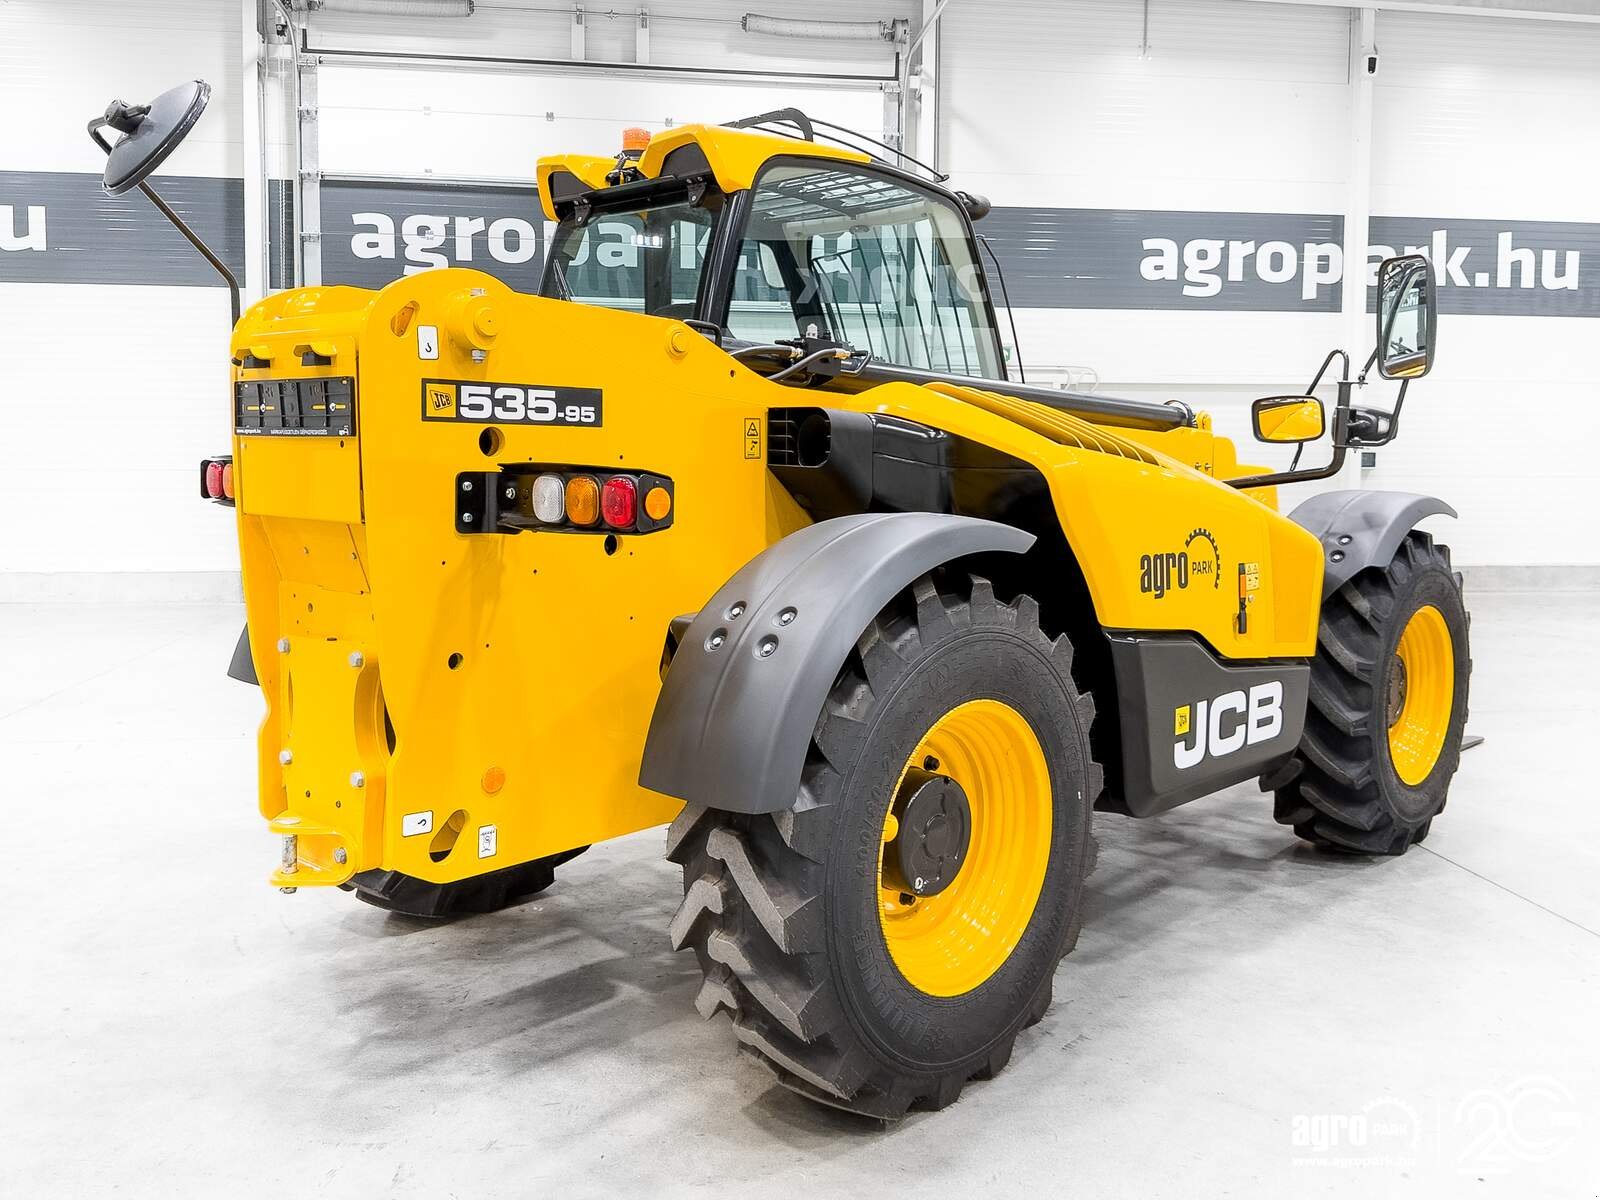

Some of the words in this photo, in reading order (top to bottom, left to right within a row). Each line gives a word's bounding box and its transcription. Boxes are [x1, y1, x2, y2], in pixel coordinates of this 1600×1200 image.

[433, 391, 452, 408] JCB
[460, 385, 596, 423] 535-95
[1140, 551, 1189, 600] agro
[1192, 560, 1214, 576] PARK
[1174, 680, 1283, 769] JCB
